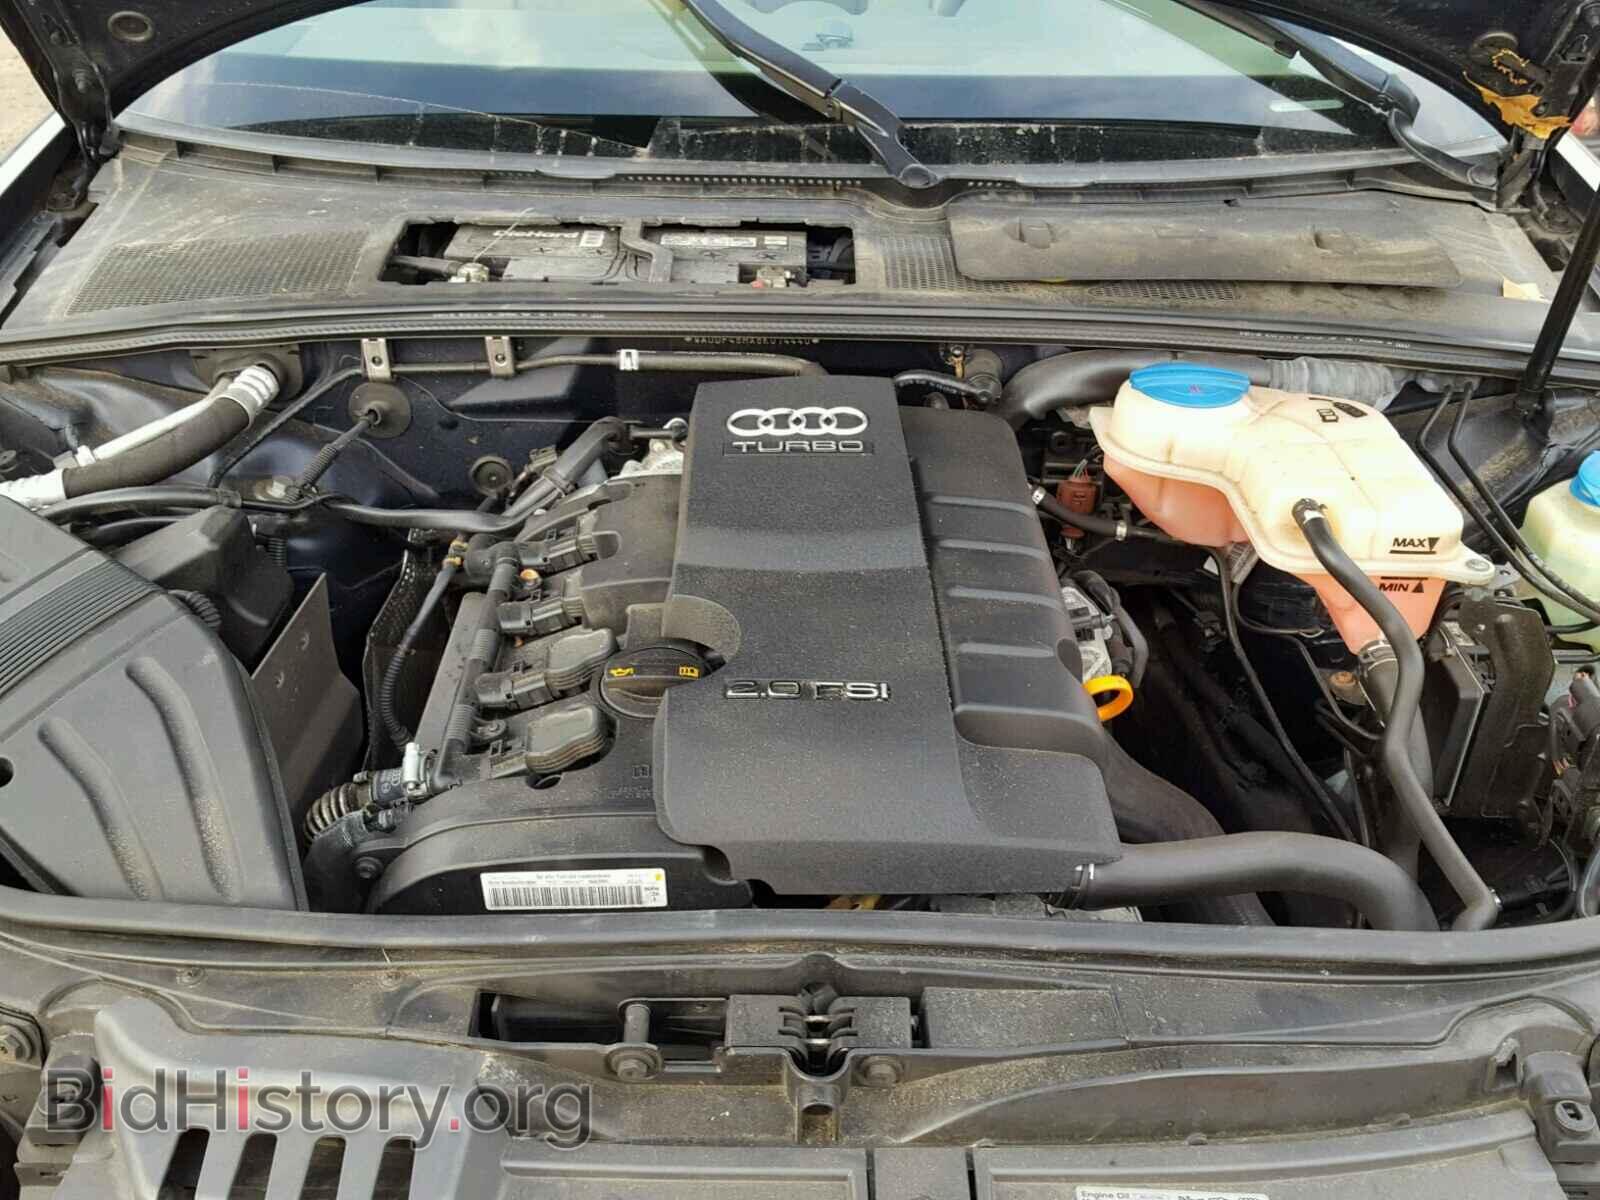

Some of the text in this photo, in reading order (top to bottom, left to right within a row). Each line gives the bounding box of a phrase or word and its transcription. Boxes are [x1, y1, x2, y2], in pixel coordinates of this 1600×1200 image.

[732, 440, 864, 453] TURBO
[1392, 537, 1427, 548] MAX
[1378, 582, 1410, 592] MIN
[725, 679, 889, 700] 2.0 FSI
